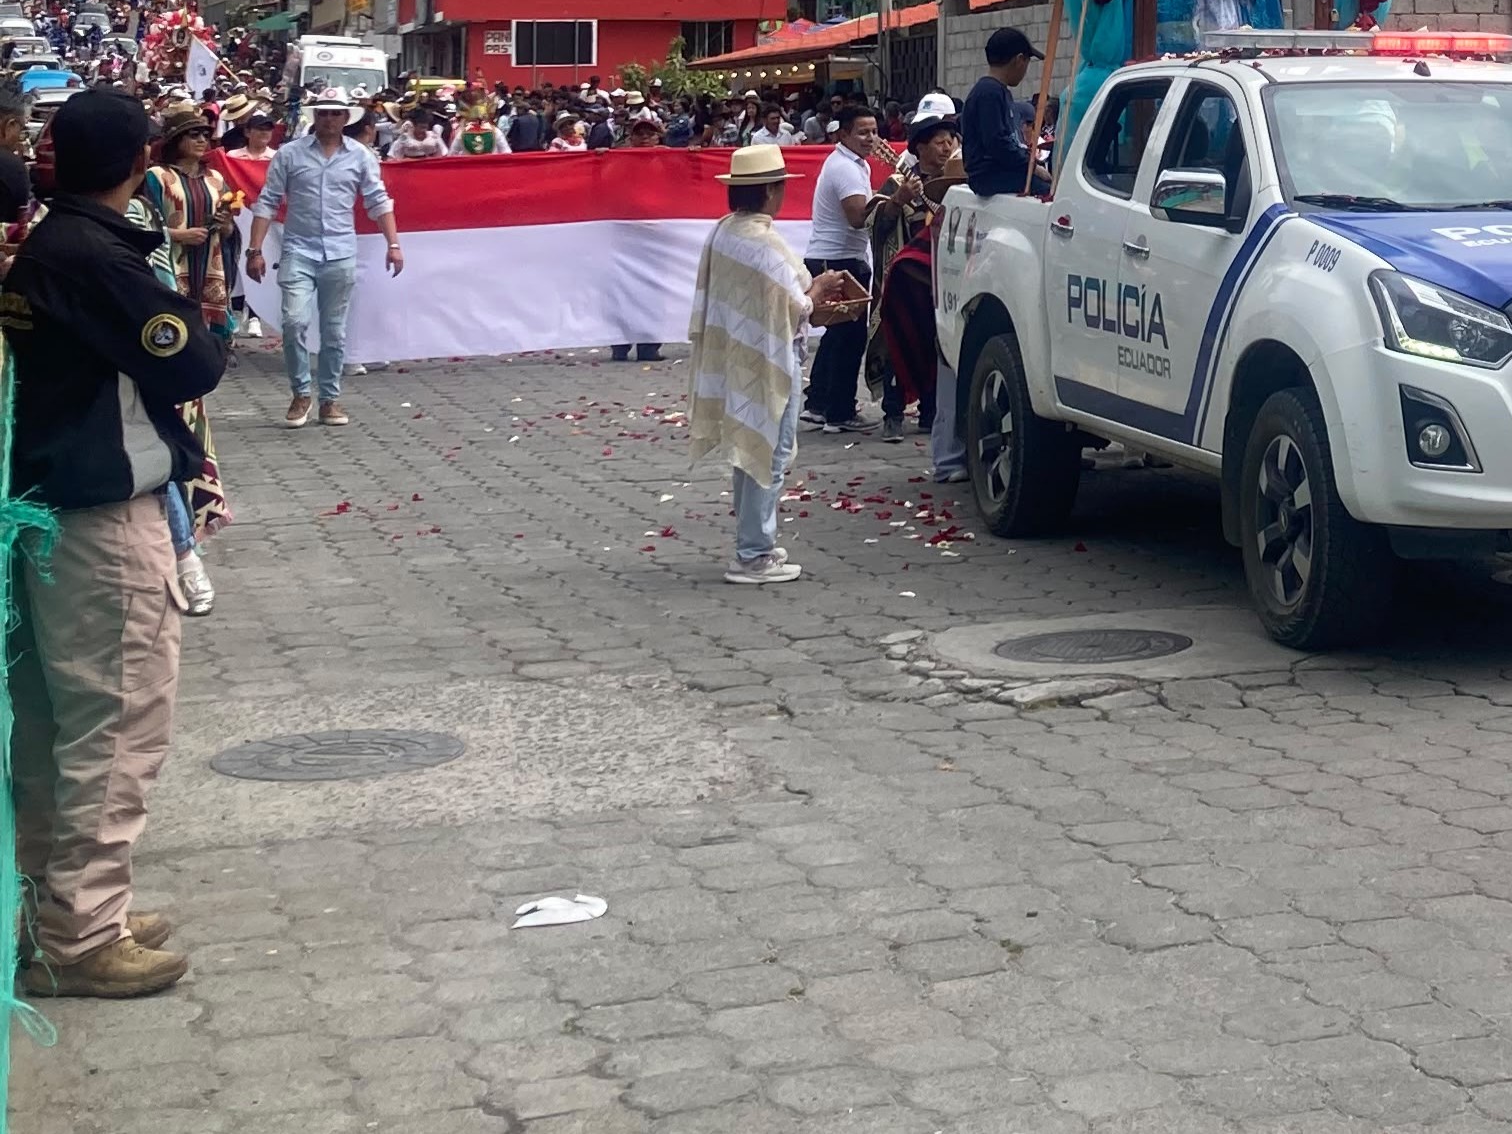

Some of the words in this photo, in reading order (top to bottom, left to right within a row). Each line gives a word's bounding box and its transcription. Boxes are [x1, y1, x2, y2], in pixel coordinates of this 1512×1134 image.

[1305, 239, 1319, 263] P
[1313, 243, 1341, 273] 0009
[1067, 273, 1170, 350] POLICÍA
[1117, 345, 1172, 379] ECUADOR
